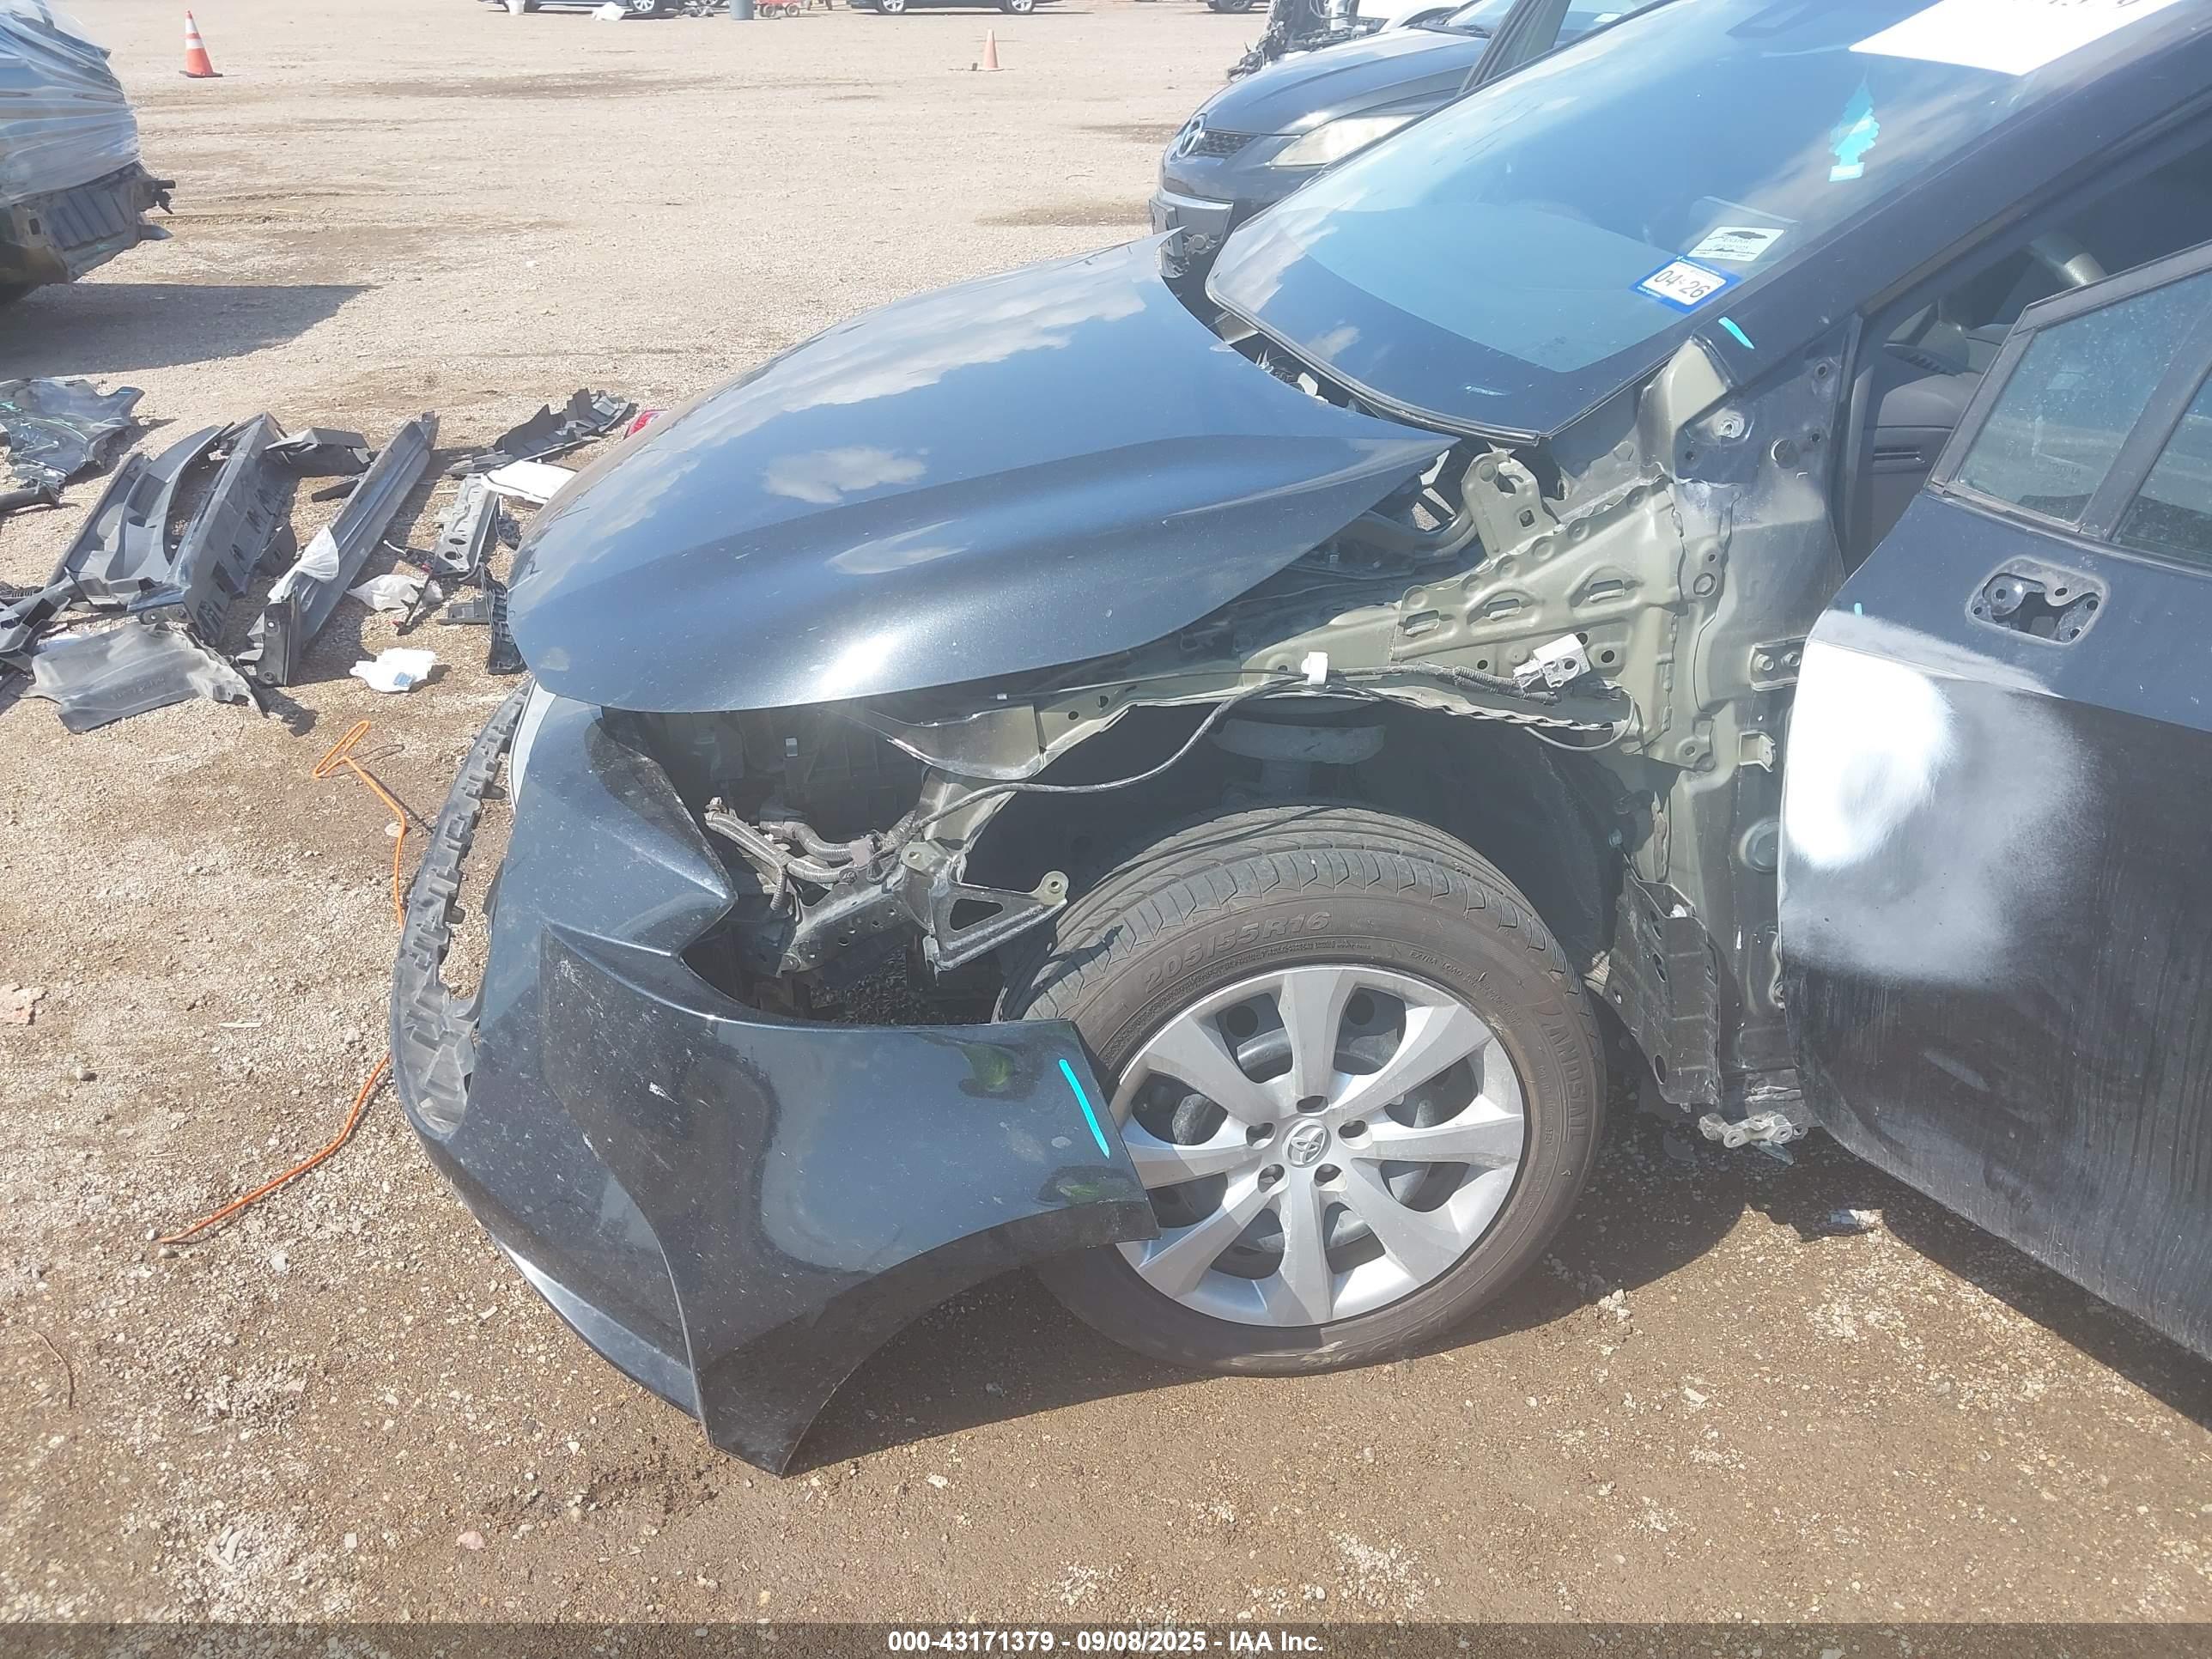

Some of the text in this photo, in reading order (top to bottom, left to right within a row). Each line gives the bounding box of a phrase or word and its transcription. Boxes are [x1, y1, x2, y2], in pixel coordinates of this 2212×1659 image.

[1654, 270, 1683, 287] 04
[1678, 281, 1711, 298] 26
[1144, 911, 1333, 994] 205/55R16
